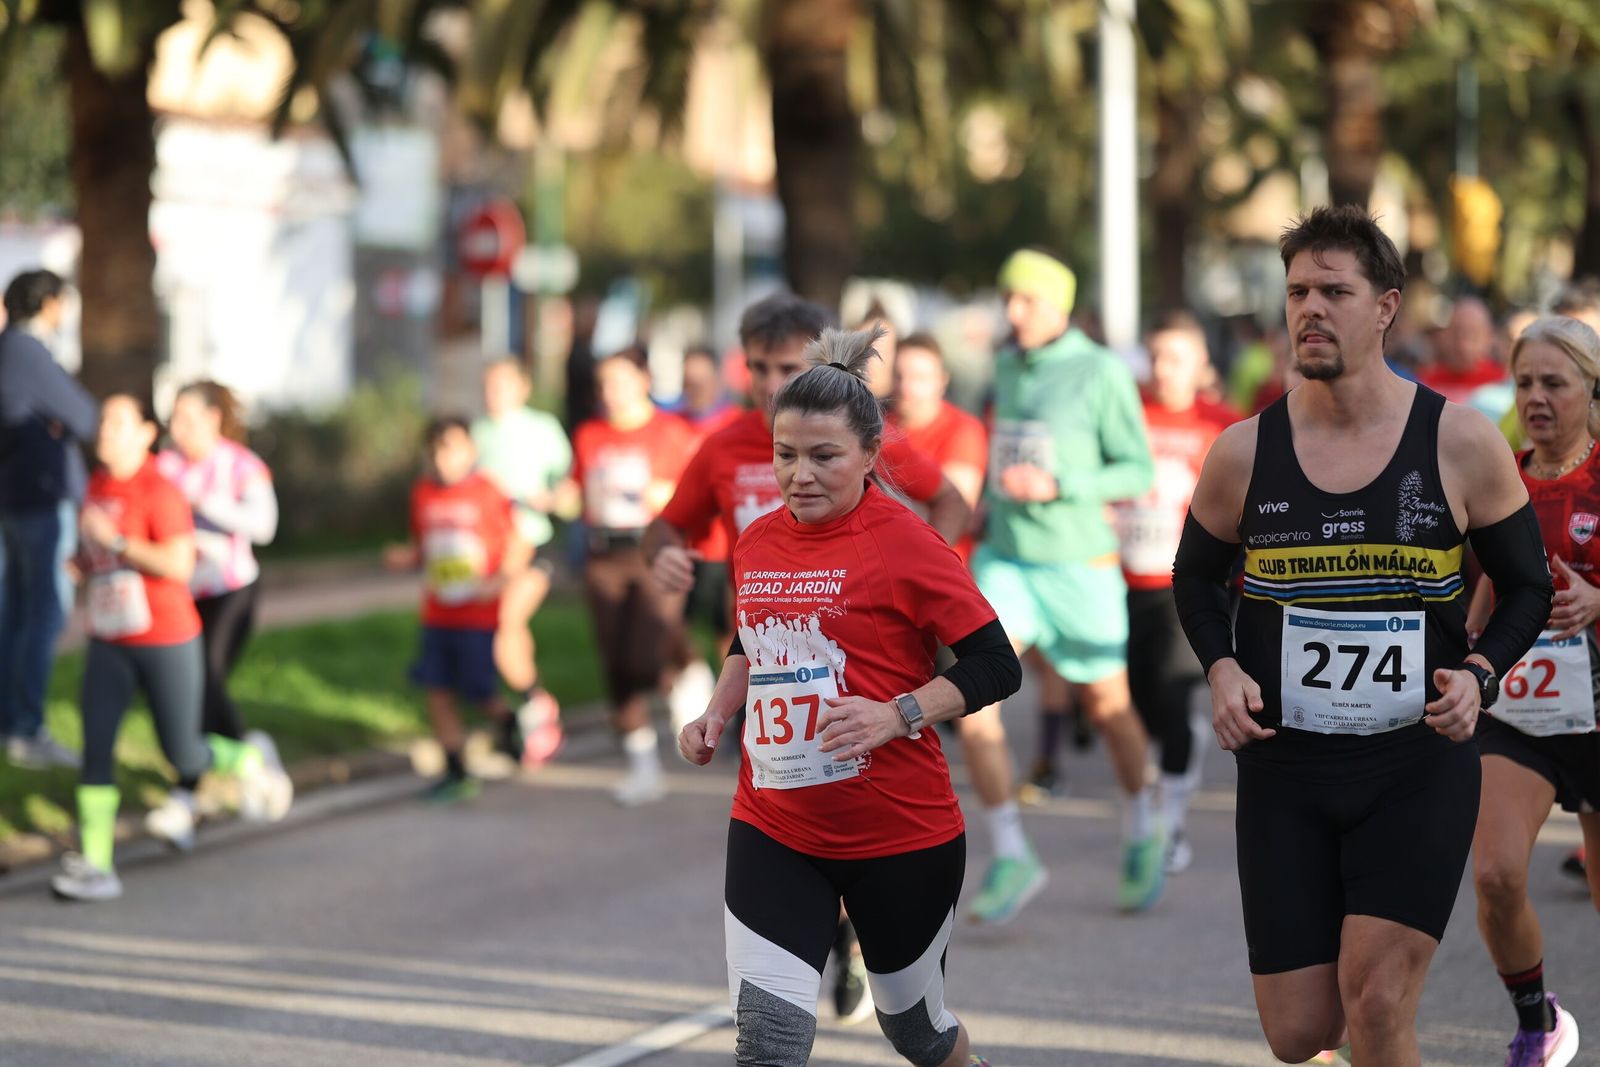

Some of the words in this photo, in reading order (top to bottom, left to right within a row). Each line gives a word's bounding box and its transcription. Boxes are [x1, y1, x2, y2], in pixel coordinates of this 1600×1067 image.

[1258, 501, 1289, 514] vive
[1321, 521, 1366, 538] gross
[1258, 557, 1287, 575] CLUB
[1288, 548, 1370, 574] TRIATLÓN
[1373, 549, 1438, 575] MÁLAGA
[752, 570, 791, 580] CARRERA
[793, 570, 830, 579] URBANA
[832, 569, 848, 579] DE
[739, 582, 782, 597] CIUDAD
[785, 578, 842, 595] JARDÍN
[1301, 641, 1407, 692] 274
[1504, 658, 1560, 700] 62
[753, 694, 820, 745] 137
